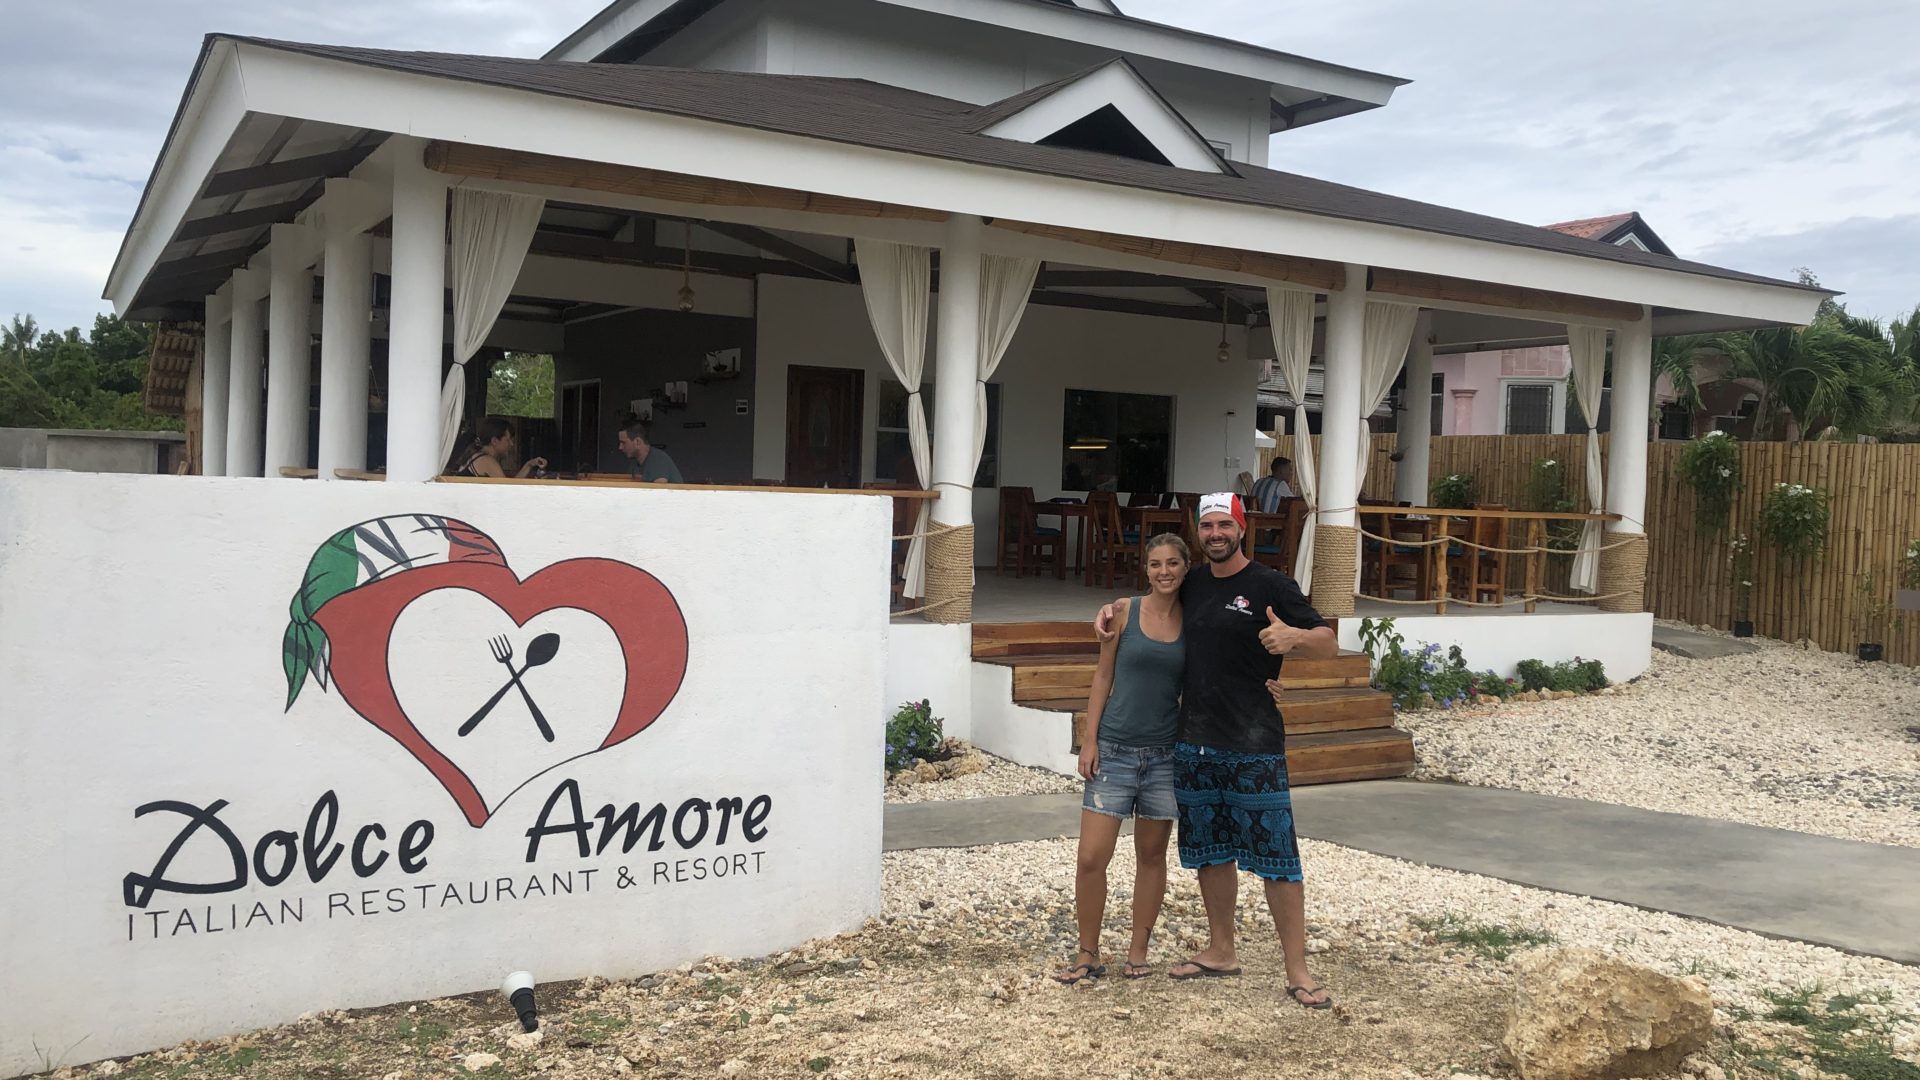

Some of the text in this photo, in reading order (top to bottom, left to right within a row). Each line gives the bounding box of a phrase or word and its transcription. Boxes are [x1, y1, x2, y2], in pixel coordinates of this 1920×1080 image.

[123, 778, 773, 909] Dolce Amore
[129, 850, 766, 942] ITALIAN RESTAURANT & RESORT
